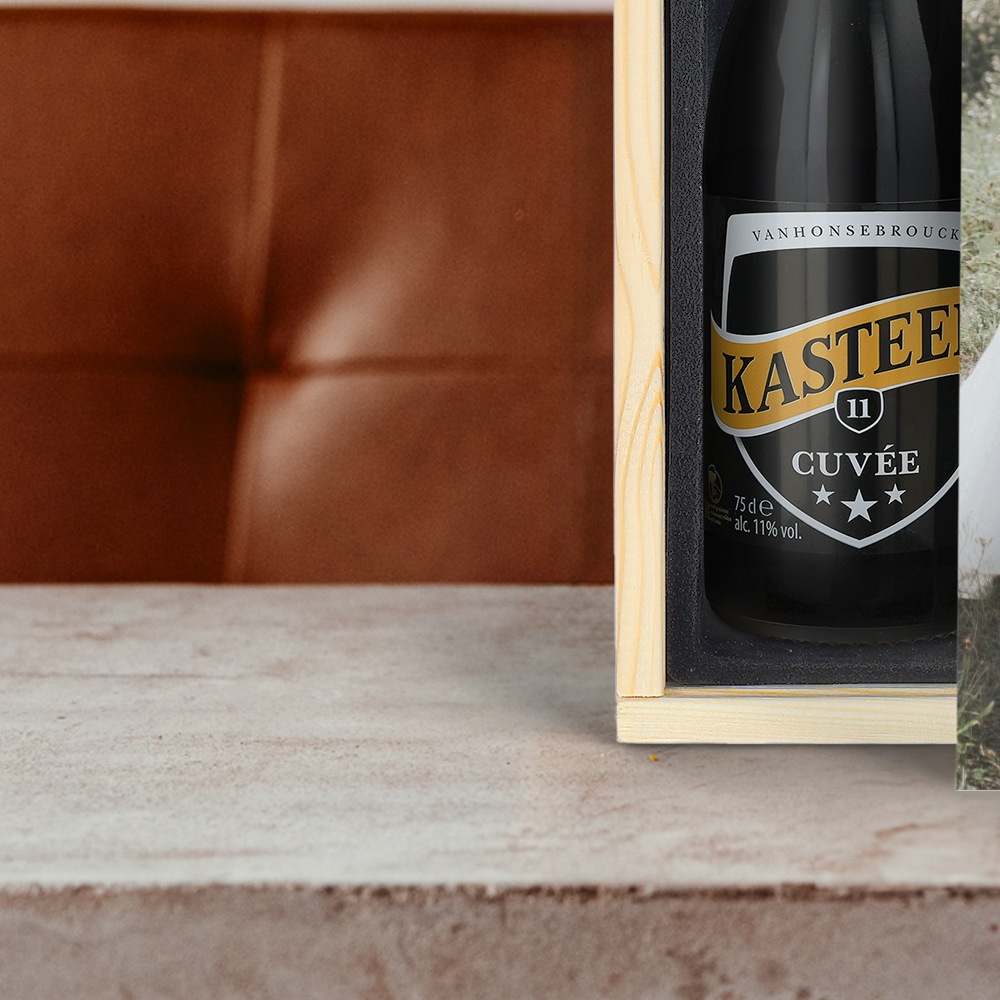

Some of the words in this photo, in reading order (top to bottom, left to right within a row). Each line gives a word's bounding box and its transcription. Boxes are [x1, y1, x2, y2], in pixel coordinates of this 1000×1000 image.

[752, 224, 959, 242] VANHONSEBROUCK
[846, 398, 872, 419] 11
[791, 444, 920, 477] CUVÉE
[734, 495, 746, 512] 75
[734, 515, 750, 533] alc.
[753, 518, 778, 537] 11%
[780, 522, 802, 540] vol.
